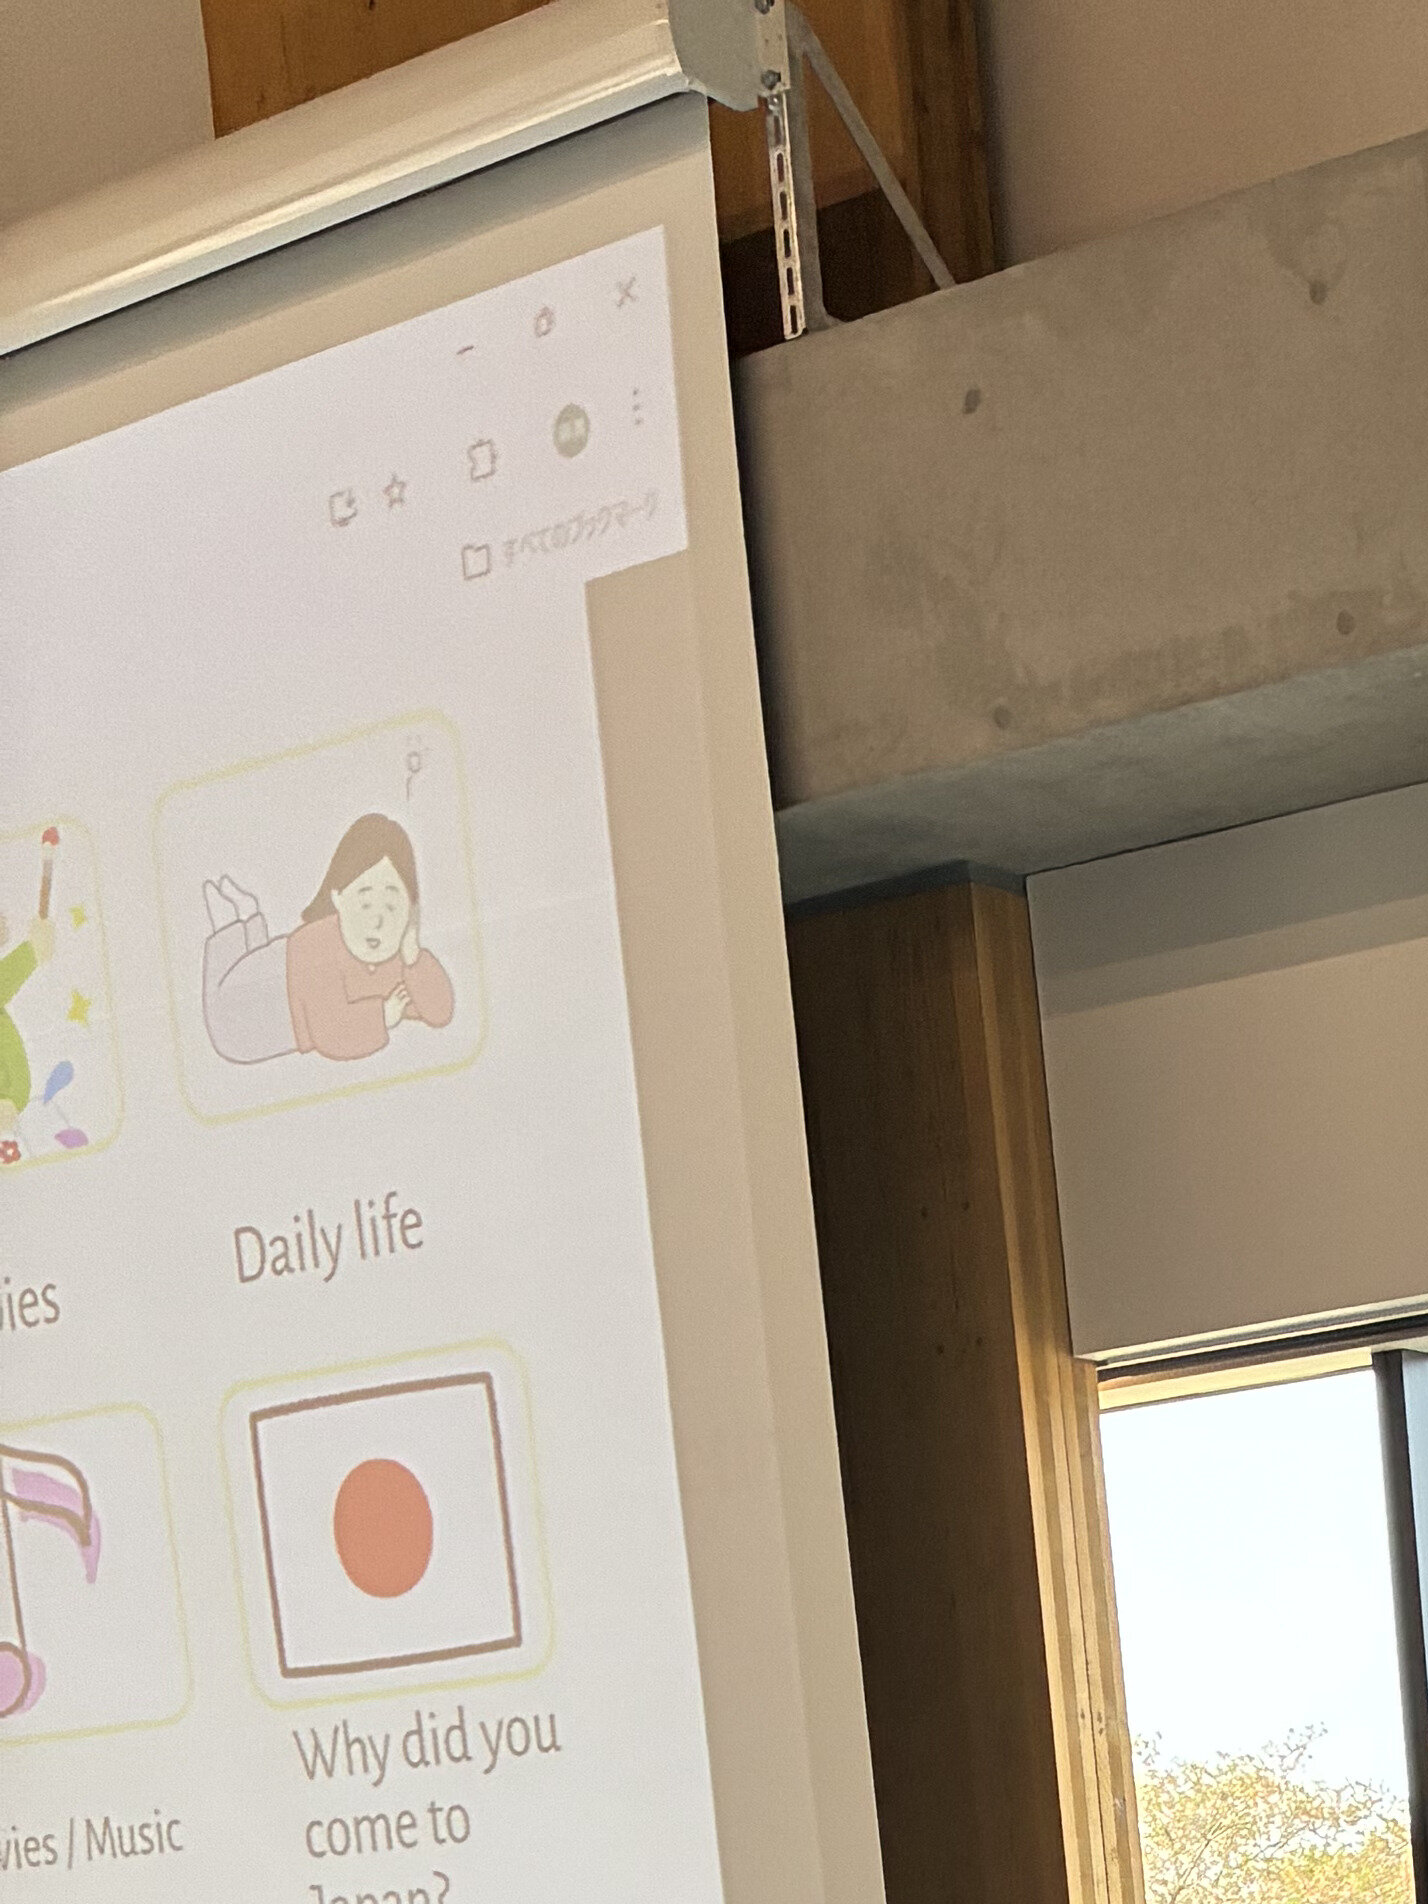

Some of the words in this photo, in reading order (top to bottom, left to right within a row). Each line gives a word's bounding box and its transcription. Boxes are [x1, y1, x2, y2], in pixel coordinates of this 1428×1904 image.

[233, 1208, 343, 1284] Daily
[353, 1191, 424, 1260] life
[0, 1276, 60, 1332] ies
[292, 1719, 390, 1787] Why
[402, 1705, 472, 1768] did
[478, 1713, 562, 1775] you
[85, 1808, 183, 1861] Music
[305, 1807, 418, 1858] come
[427, 1800, 471, 1844] to
